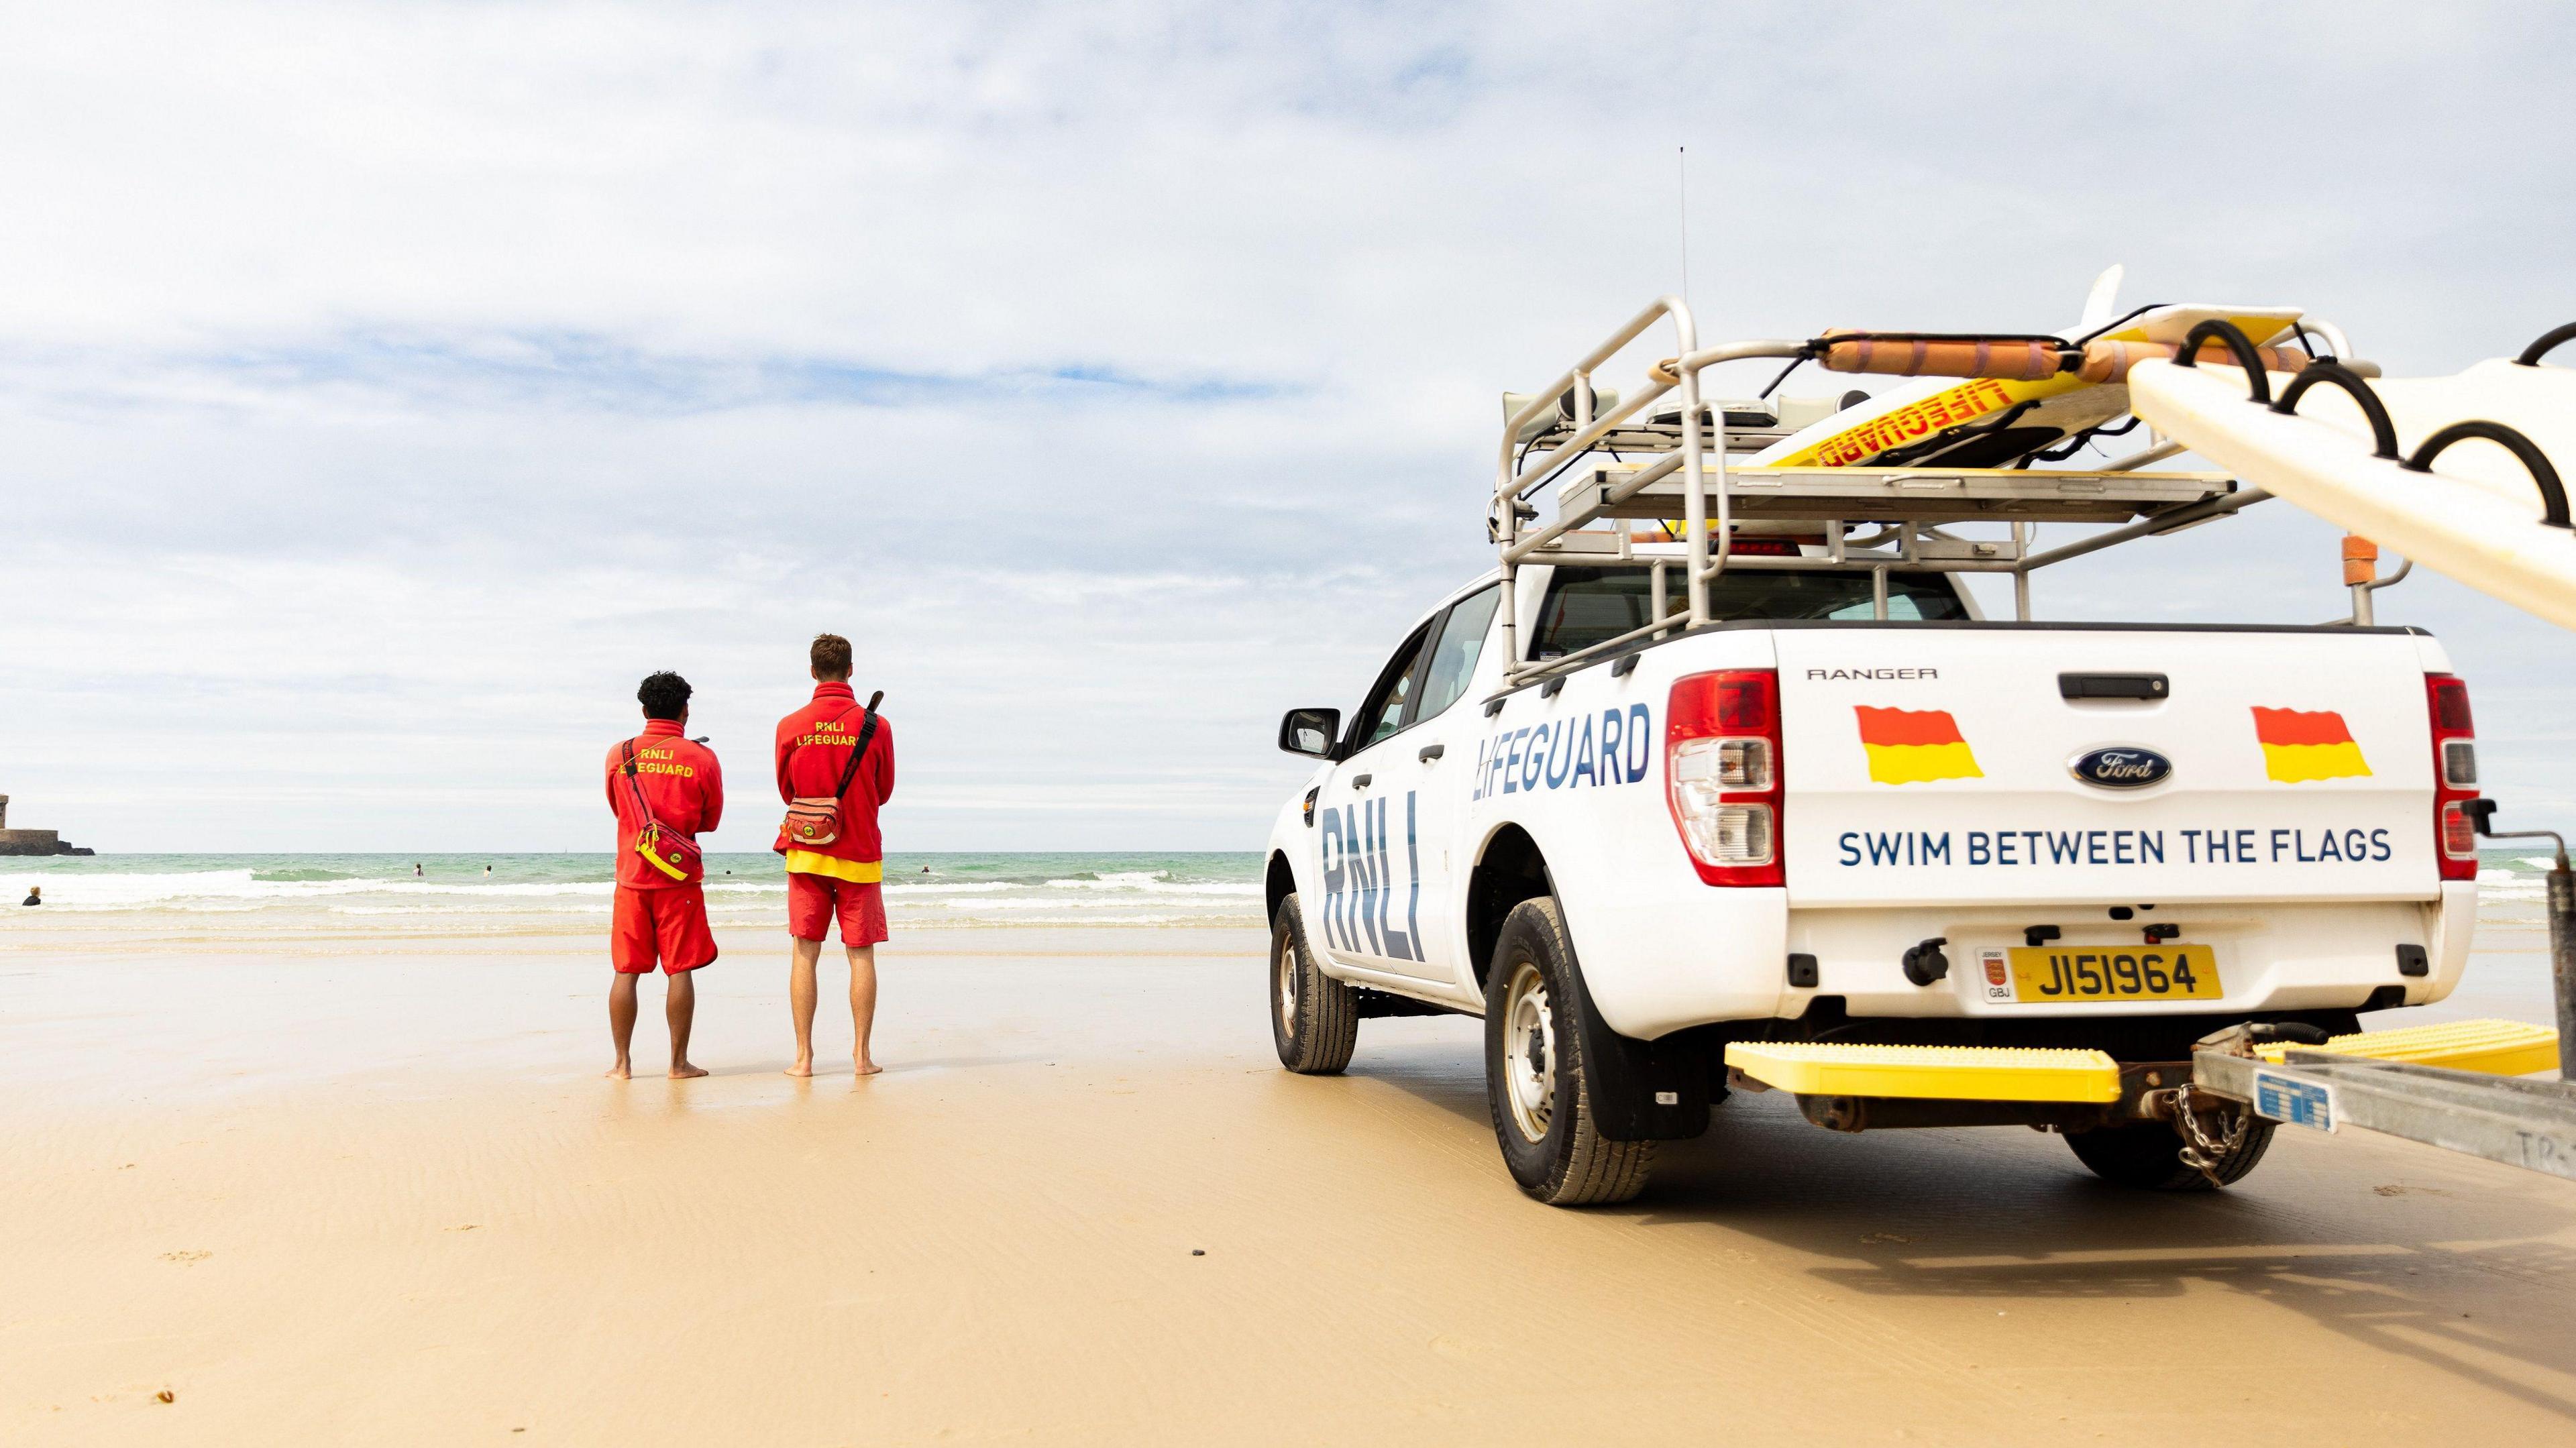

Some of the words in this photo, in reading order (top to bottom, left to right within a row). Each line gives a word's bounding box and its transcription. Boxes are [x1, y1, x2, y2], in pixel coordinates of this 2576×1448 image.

[1817, 378, 2013, 467] LIFEGUARD
[1807, 668, 1938, 680] RANGER
[815, 722, 845, 732] RNLI
[796, 734, 859, 746] LIFEGUAR
[641, 748, 674, 760] RNLI
[1472, 702, 1650, 801] LIFEGUARD
[619, 762, 694, 778] LEGUARD
[2096, 752, 2155, 779] Ford
[1838, 832, 1951, 867] SWIM
[1968, 830, 2165, 865] BETWEEN
[2180, 829, 2257, 864] THE
[2270, 828, 2392, 862] FLAGS
[1322, 790, 1426, 963] RNLI
[1988, 988, 2010, 998] GBJ
